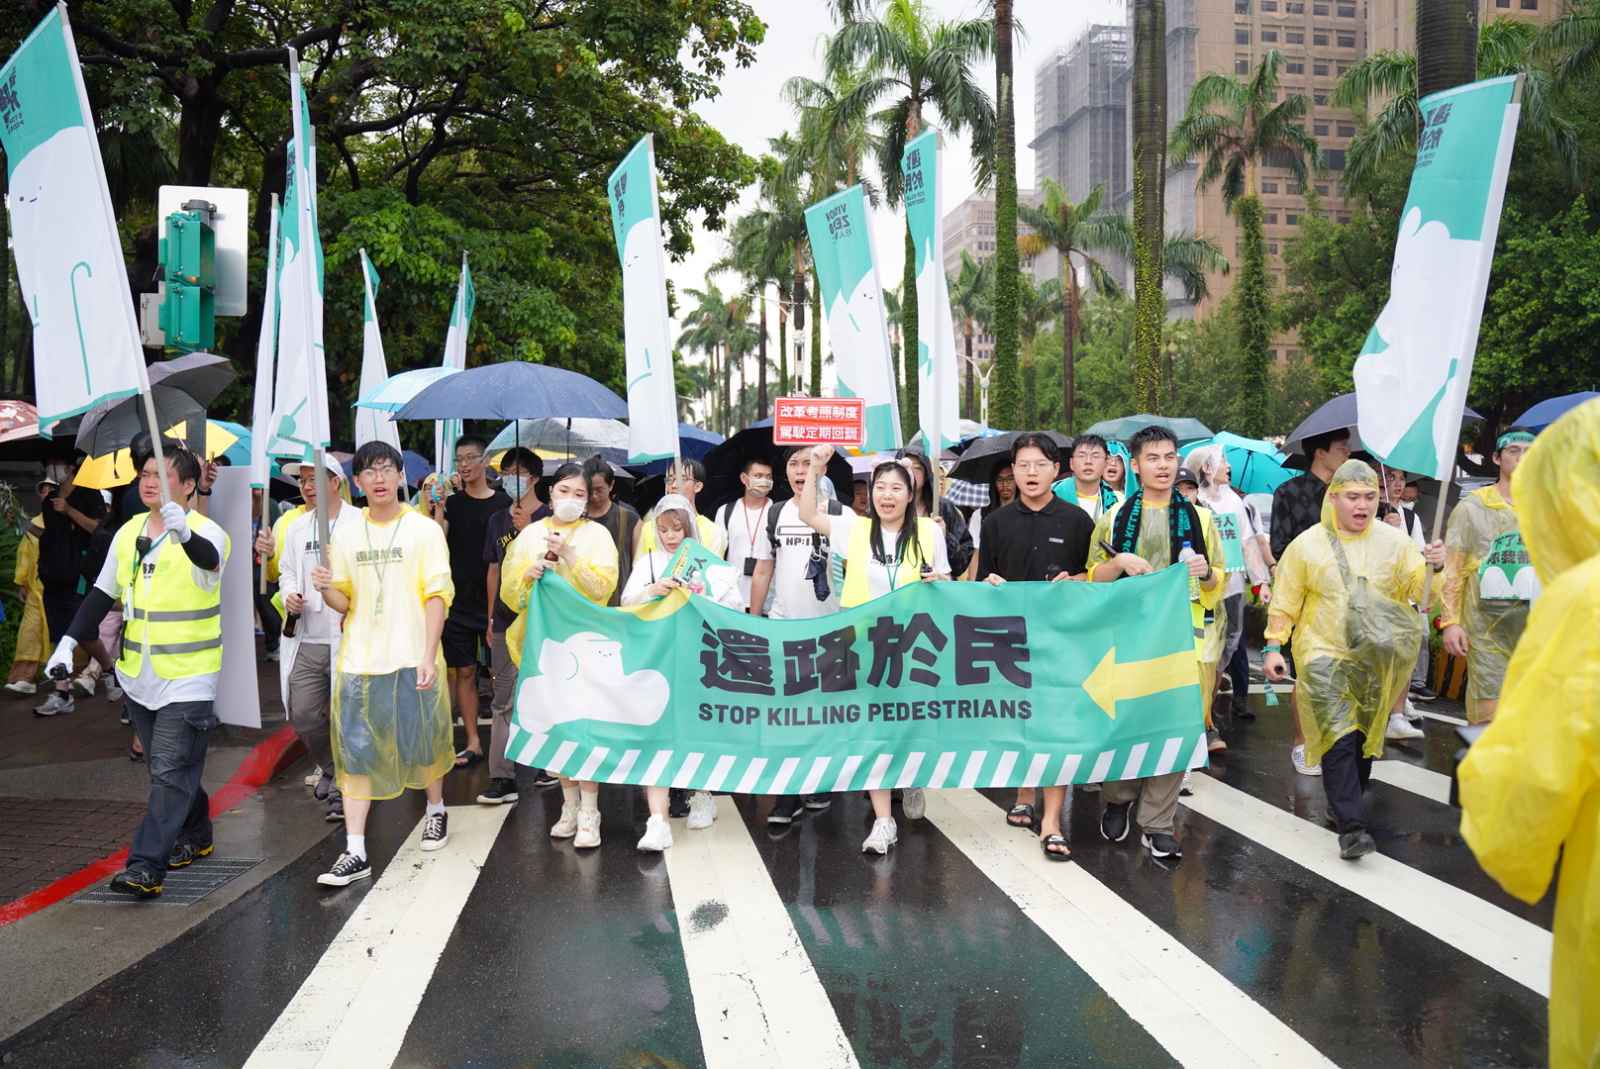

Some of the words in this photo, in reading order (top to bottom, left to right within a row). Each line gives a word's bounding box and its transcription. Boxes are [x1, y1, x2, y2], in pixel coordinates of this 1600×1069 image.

[699, 613, 1033, 697] 還路於民
[699, 703, 760, 725] STOP
[767, 704, 861, 726] KILLING
[867, 699, 1033, 722] PEDESTRIANS
